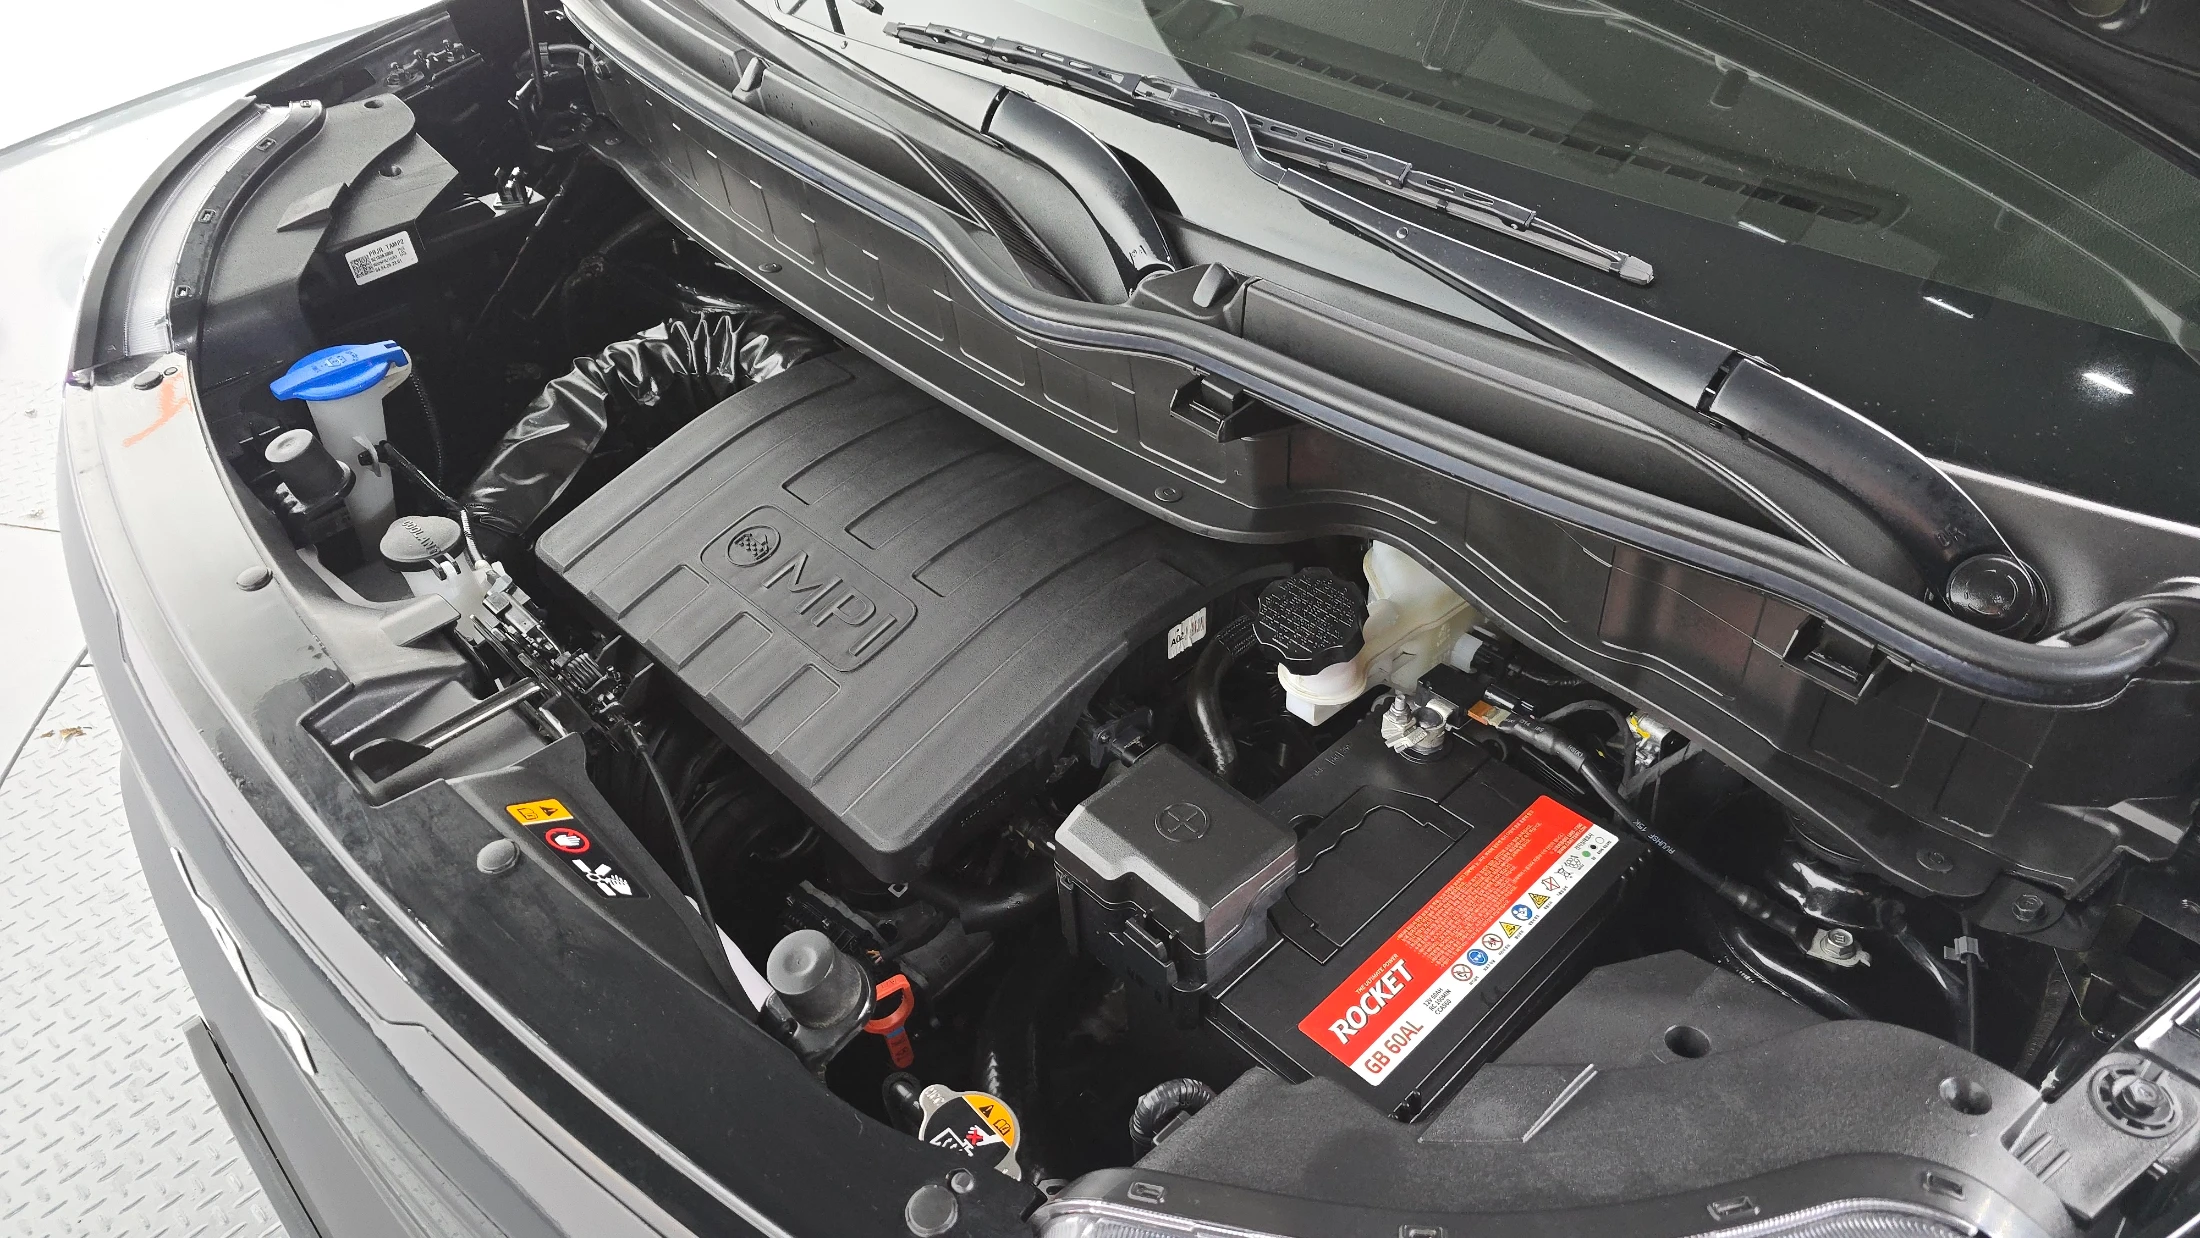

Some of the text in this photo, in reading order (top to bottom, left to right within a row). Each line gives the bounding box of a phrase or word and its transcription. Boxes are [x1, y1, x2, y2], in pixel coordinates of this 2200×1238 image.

[401, 518, 443, 556] COOLANT
[763, 550, 897, 657] MPI
[1354, 953, 1398, 994] THE ULTIMATE POWER
[1328, 959, 1414, 1044] ROCKET
[1422, 987, 1443, 1007] 12V 60AH
[1428, 1003, 1436, 1011] RC
[1364, 1020, 1424, 1074] GB 60AL
